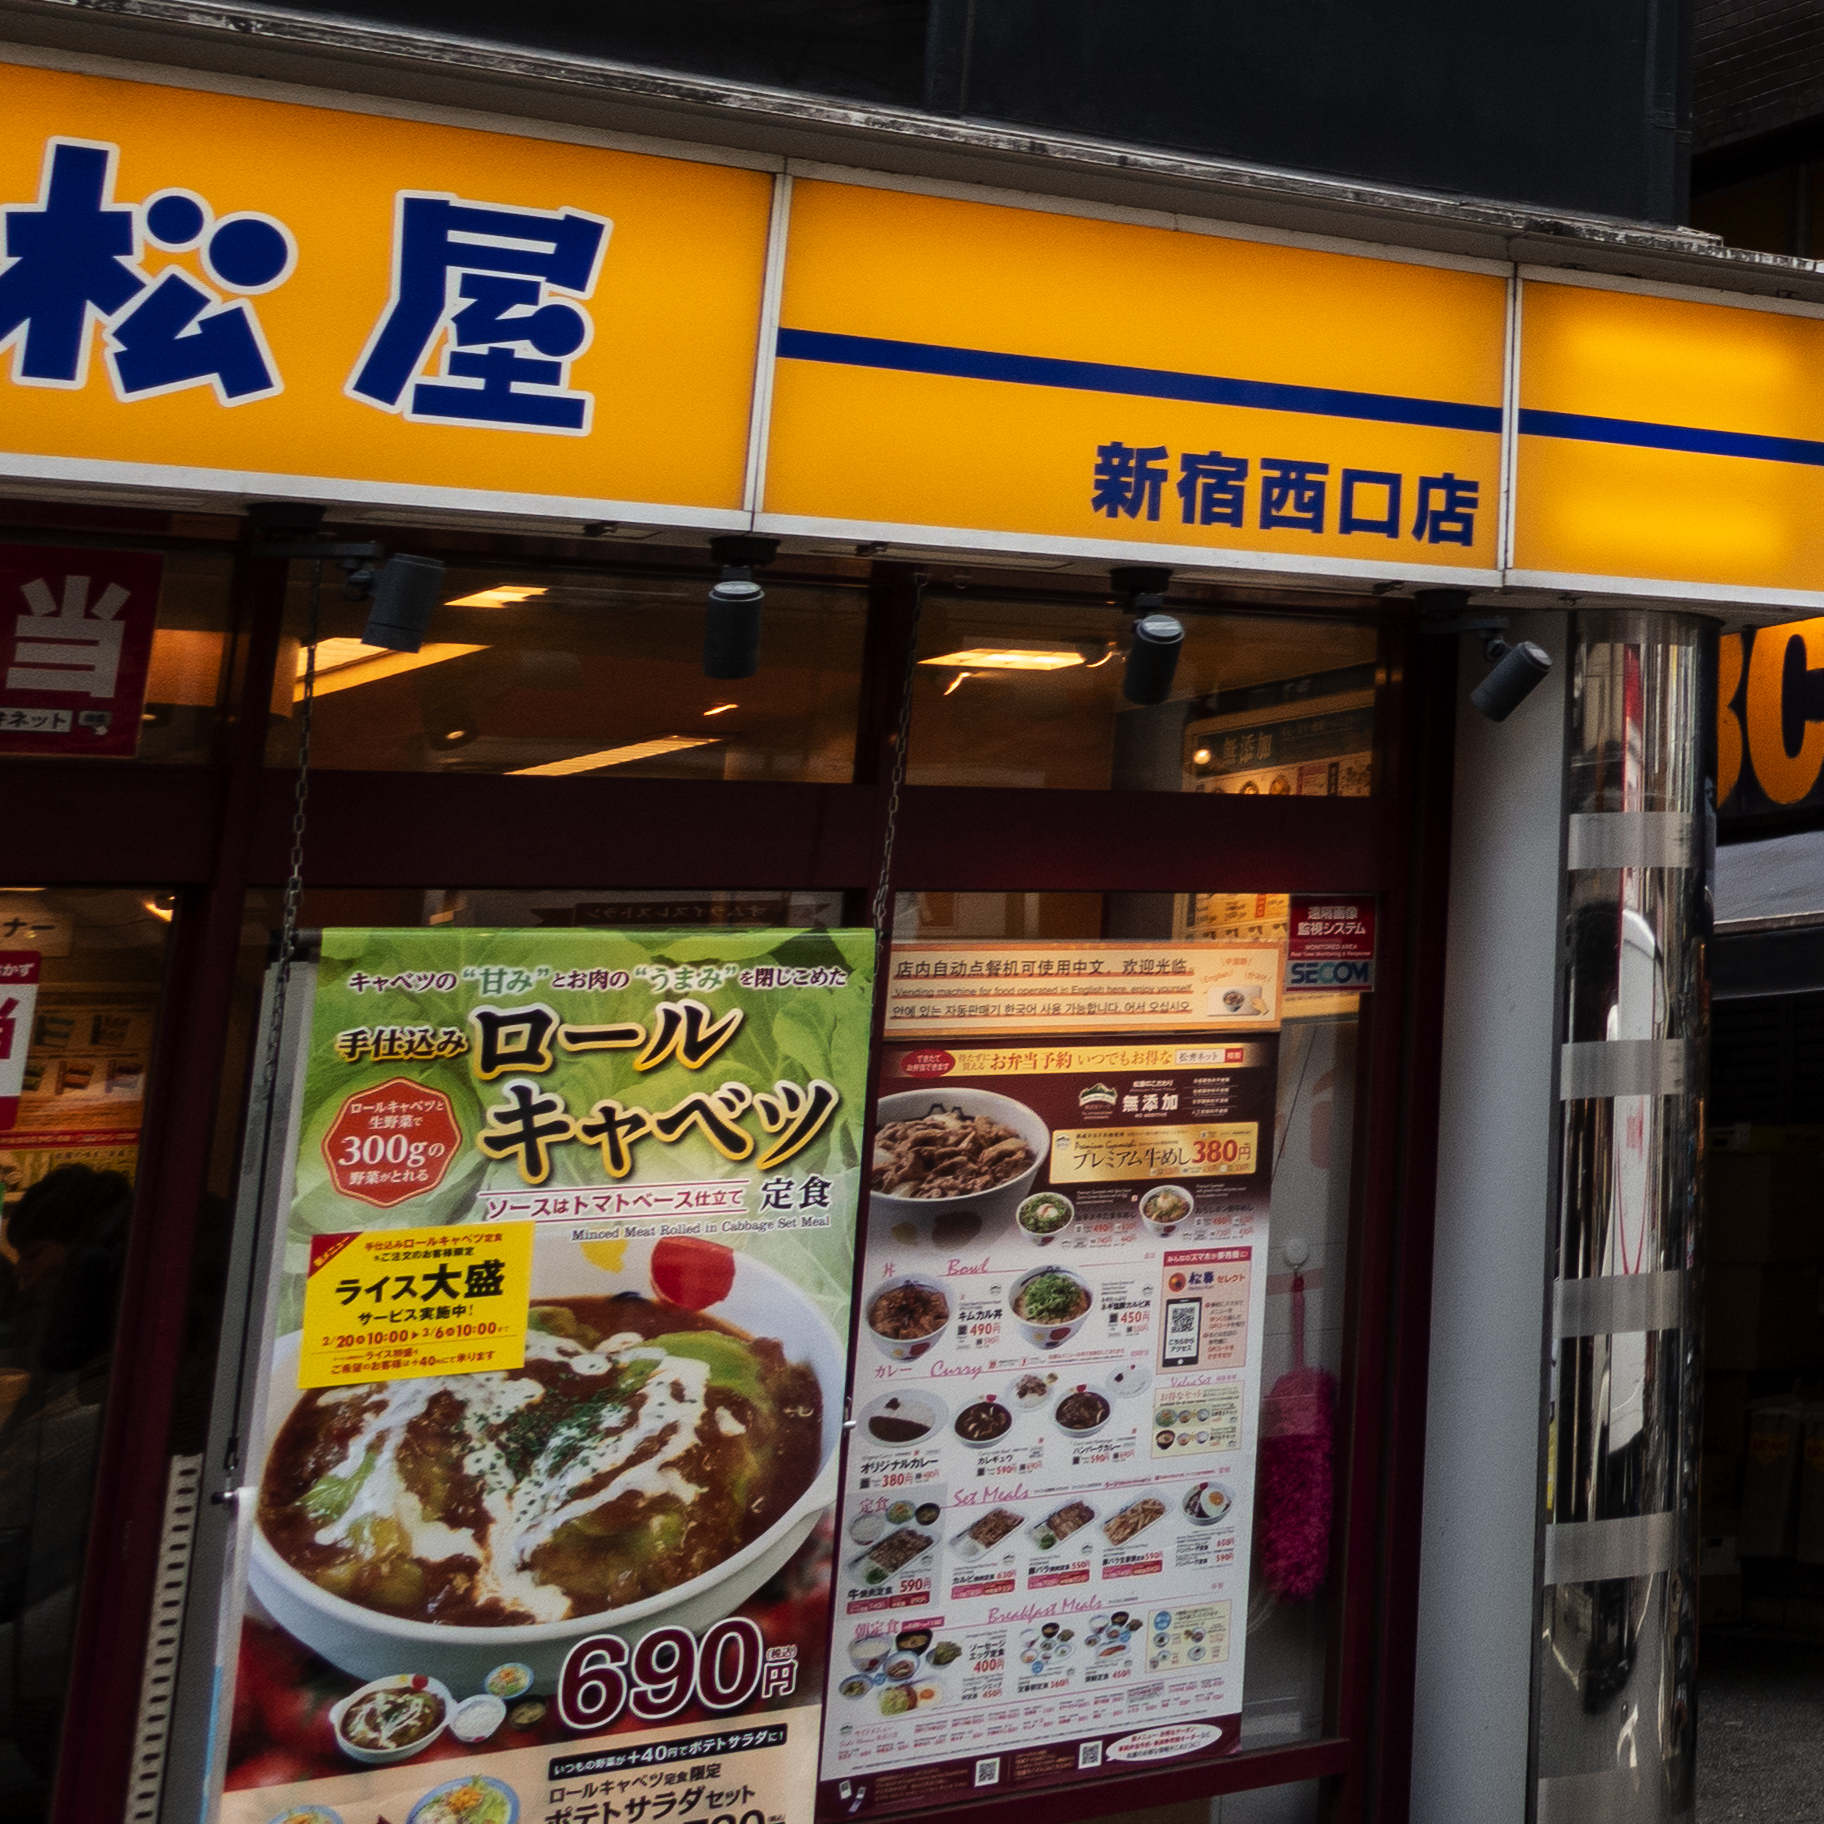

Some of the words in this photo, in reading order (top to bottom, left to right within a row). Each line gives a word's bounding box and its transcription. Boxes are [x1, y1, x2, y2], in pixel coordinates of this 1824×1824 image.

[0, 136, 613, 437] 松屋
[1091, 440, 1481, 548] 新宿西口店
[1296, 921, 1367, 937] 監視システム
[1290, 961, 1370, 985] SECOM
[336, 1027, 469, 1063] 手仕込み
[468, 998, 745, 1080] ロール
[989, 1051, 1073, 1070] お弁当予約
[348, 1098, 445, 1115] ロールキャベツと
[1121, 1093, 1179, 1113] 無添加
[476, 1078, 841, 1185] キャベツ
[338, 1134, 446, 1169] 300gの
[486, 1190, 745, 1221] ソースはトマトベース仕立て
[760, 1174, 832, 1212] 定食
[624, 1223, 657, 1240] Meat
[659, 1221, 701, 1238] Rolled
[720, 1218, 774, 1237] Cabbage
[777, 1216, 799, 1231] Set
[800, 1214, 831, 1230] Meal
[946, 1256, 991, 1277] Bowl
[334, 1258, 506, 1306] ライス大盛
[929, 1359, 983, 1381] Curry
[982, 1482, 1030, 1504] Meals
[986, 1603, 1056, 1625] Breakfast
